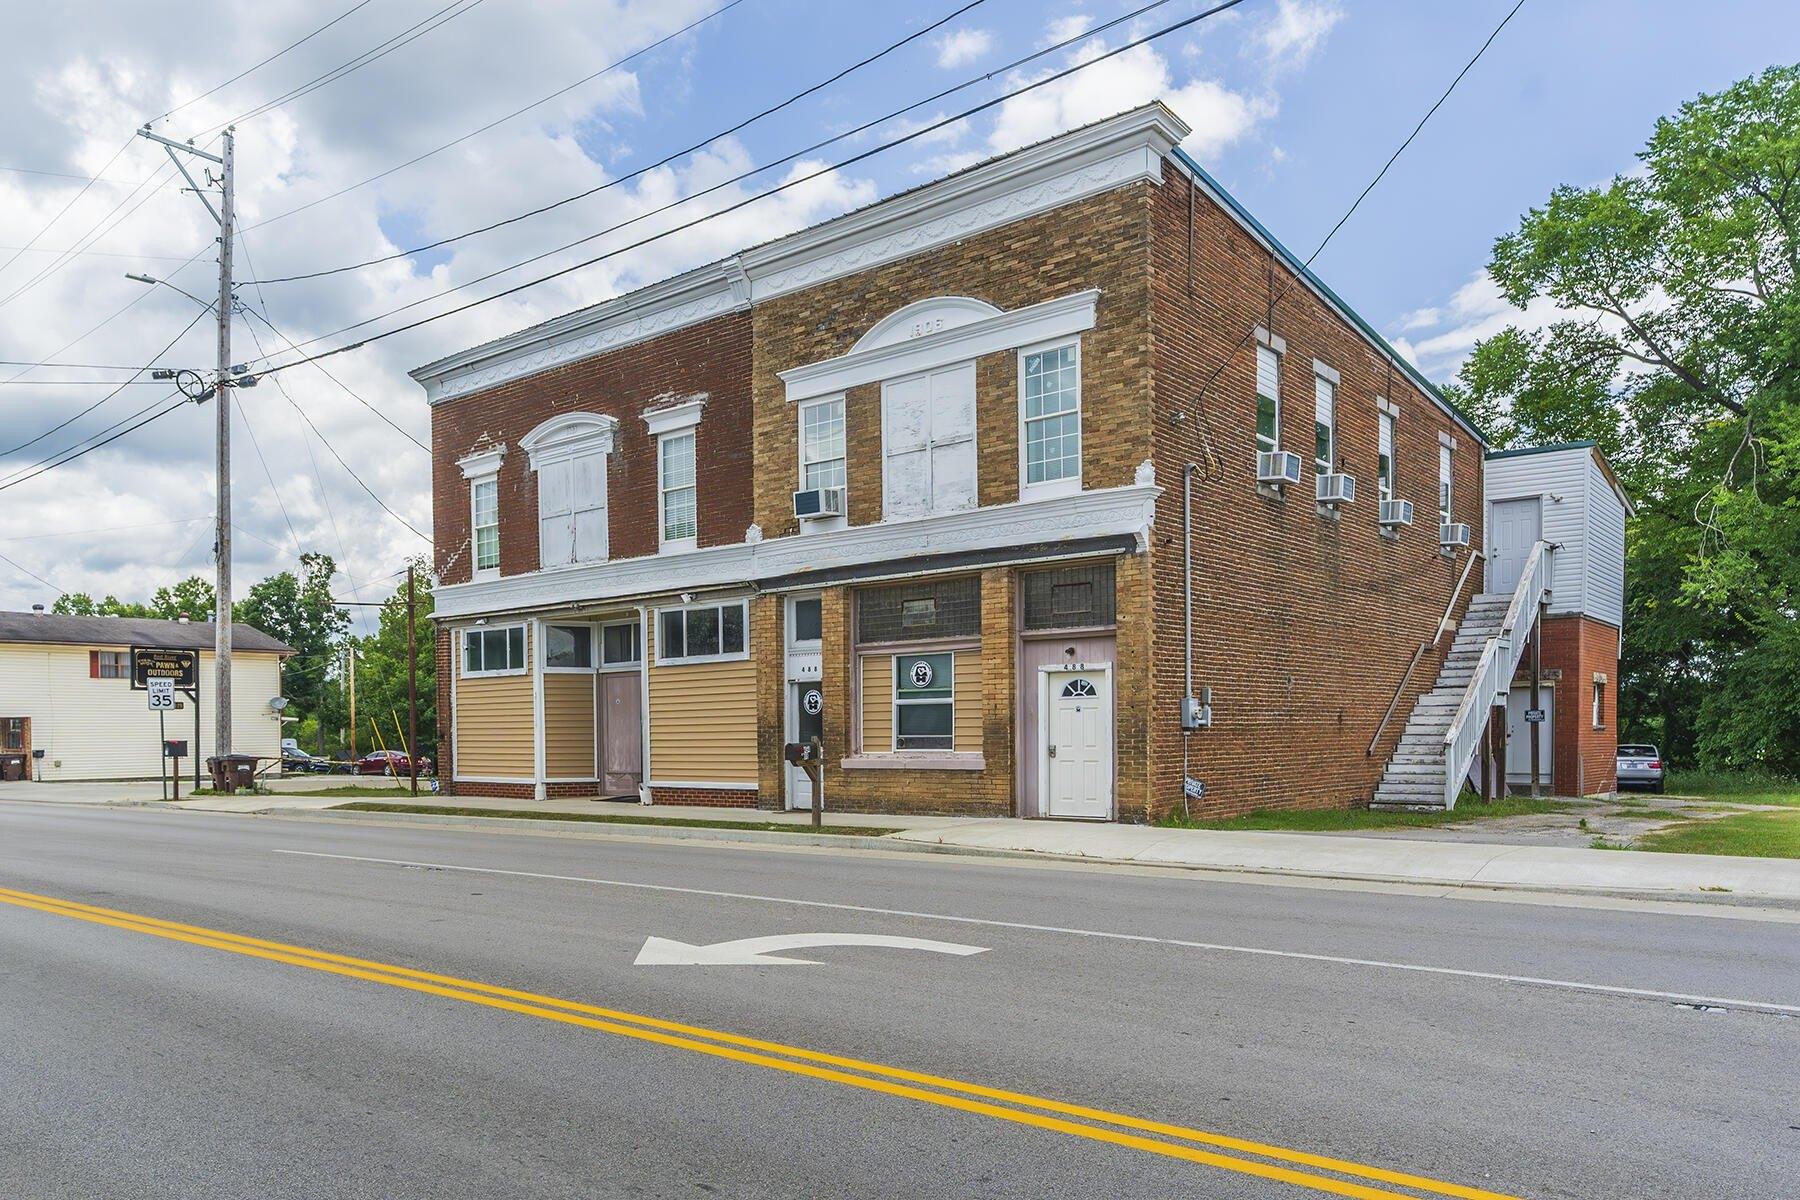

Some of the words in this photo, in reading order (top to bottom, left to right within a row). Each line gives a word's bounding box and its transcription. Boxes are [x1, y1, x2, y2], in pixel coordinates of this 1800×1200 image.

[155, 661, 175, 669] PAWN
[147, 669, 184, 677] OUTDOORS
[152, 695, 172, 707] 35
